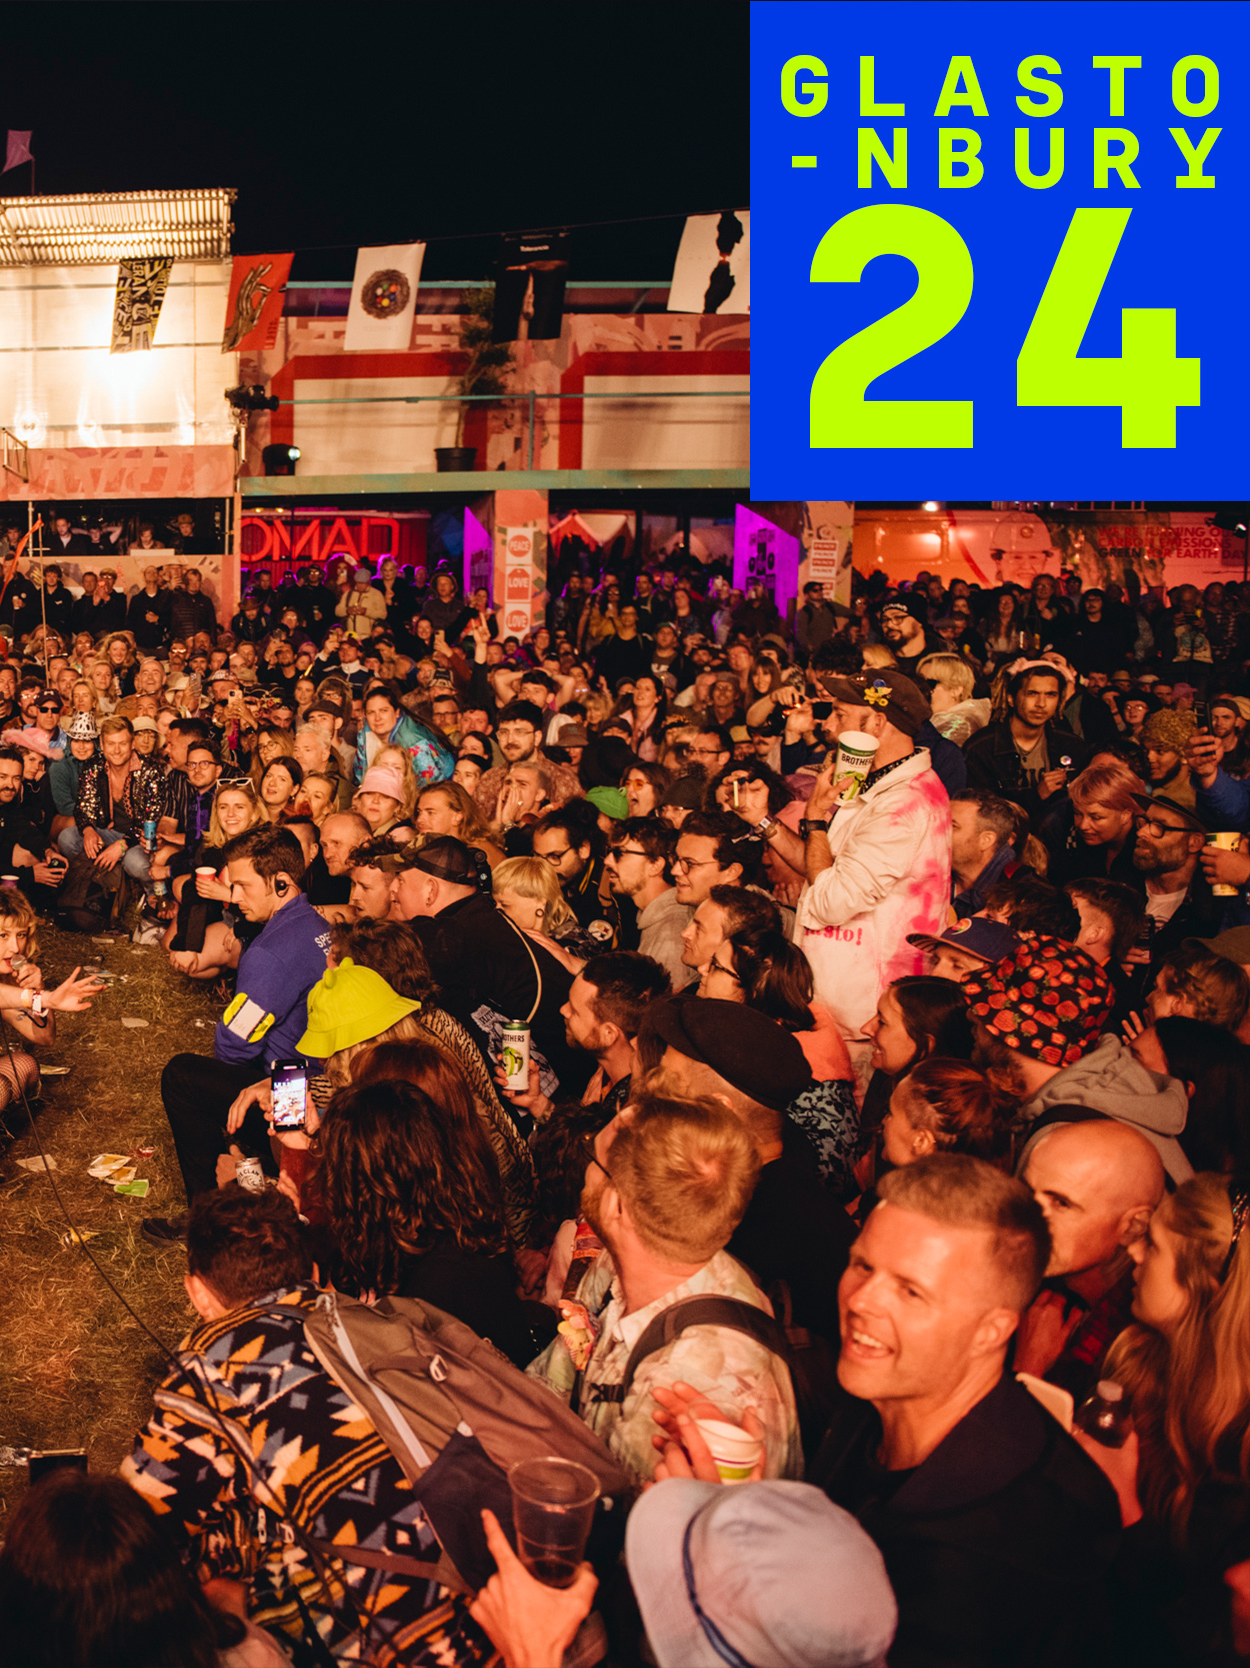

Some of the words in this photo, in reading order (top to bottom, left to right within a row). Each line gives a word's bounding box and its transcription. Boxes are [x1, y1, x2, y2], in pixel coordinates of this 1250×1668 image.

[1099, 527, 1139, 537] WE'RE
[509, 541, 529, 552] PEACE
[1099, 537, 1154, 548] CARBON
[1160, 537, 1231, 548] EMISSIONS
[1099, 548, 1142, 558] GREEN
[1147, 548, 1172, 558] FOR
[1177, 548, 1218, 559] EARTH
[508, 578, 528, 588] LOVE
[507, 615, 527, 628] LOVE
